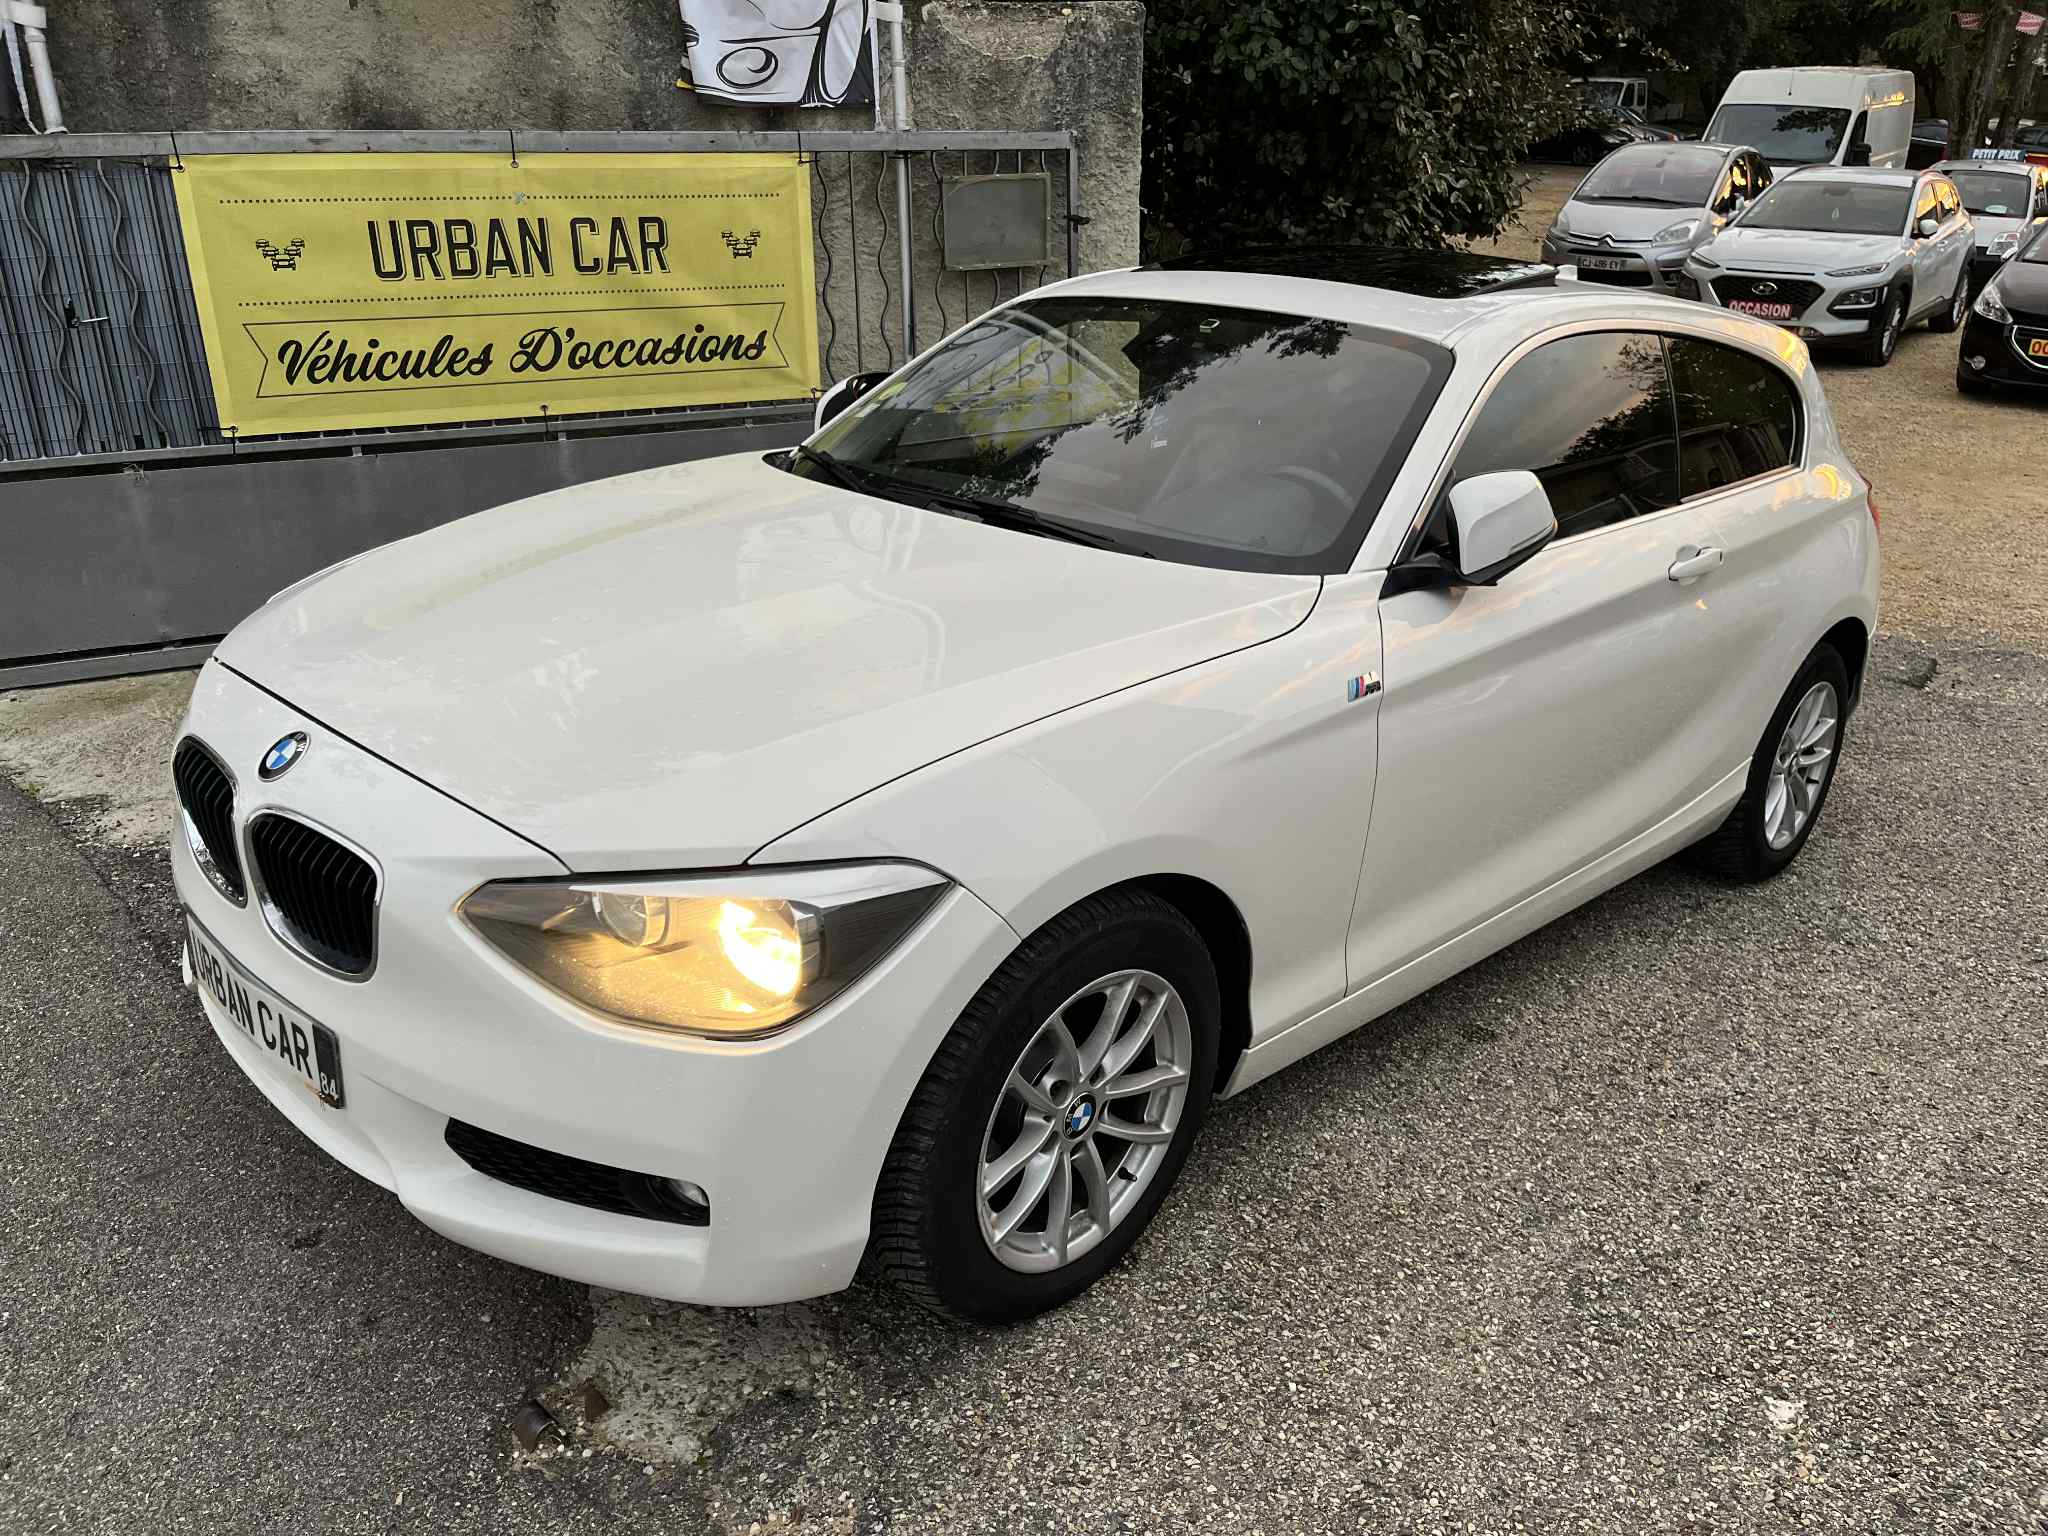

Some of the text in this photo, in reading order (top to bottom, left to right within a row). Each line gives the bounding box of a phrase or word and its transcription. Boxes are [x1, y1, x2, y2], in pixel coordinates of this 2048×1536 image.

[1972, 148, 2022, 160] PETIT PRIX
[367, 216, 672, 281] URBAN CAR
[1729, 300, 1791, 317] OCCASION
[277, 323, 768, 386] Véhicules D'occasions
[191, 930, 314, 1080] URBAN CAR
[319, 1072, 338, 1099] 84
